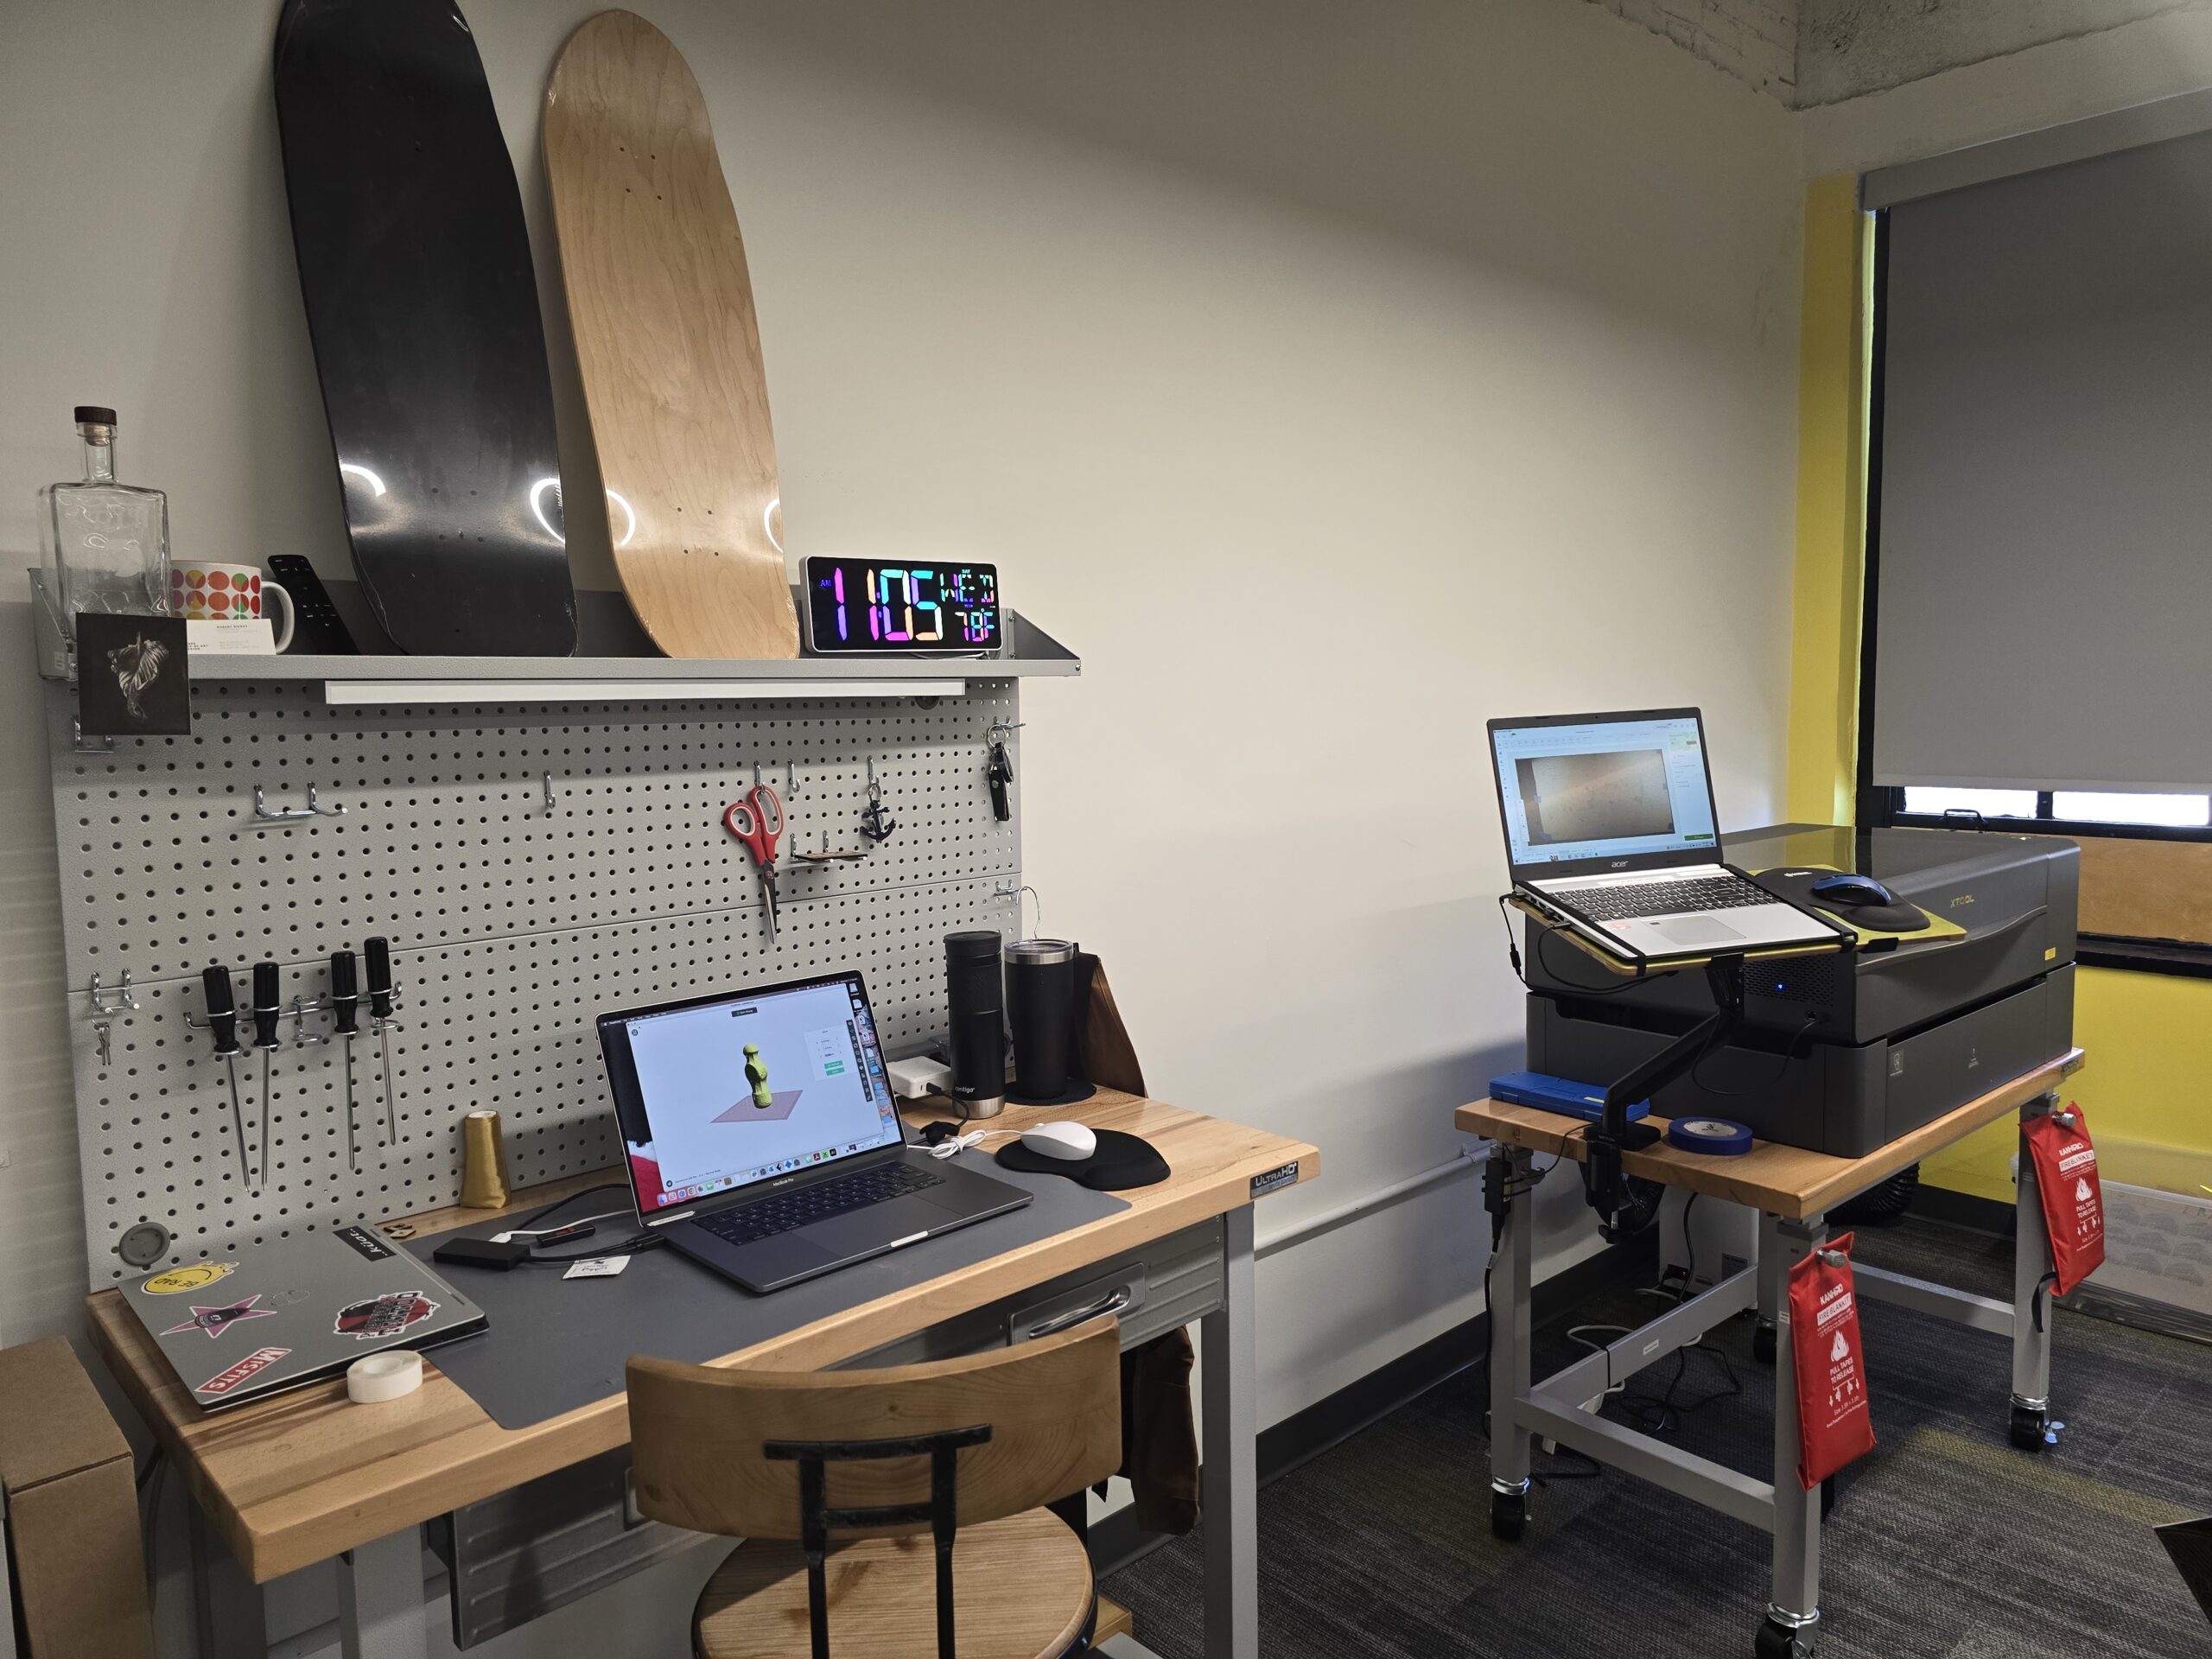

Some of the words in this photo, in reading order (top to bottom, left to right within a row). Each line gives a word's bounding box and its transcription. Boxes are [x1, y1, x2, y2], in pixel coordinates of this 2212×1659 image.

[939, 573, 995, 603] WED
[834, 567, 944, 641] 11:05
[1818, 1309, 1829, 1323] FIRE
[1829, 1294, 1850, 1315] BLANKET
[1829, 1364, 1840, 1376] PULL
[1840, 1356, 1853, 1369] TAPES
[1830, 1376, 1837, 1384] TO
[1836, 1364, 1854, 1382] RELEASE
